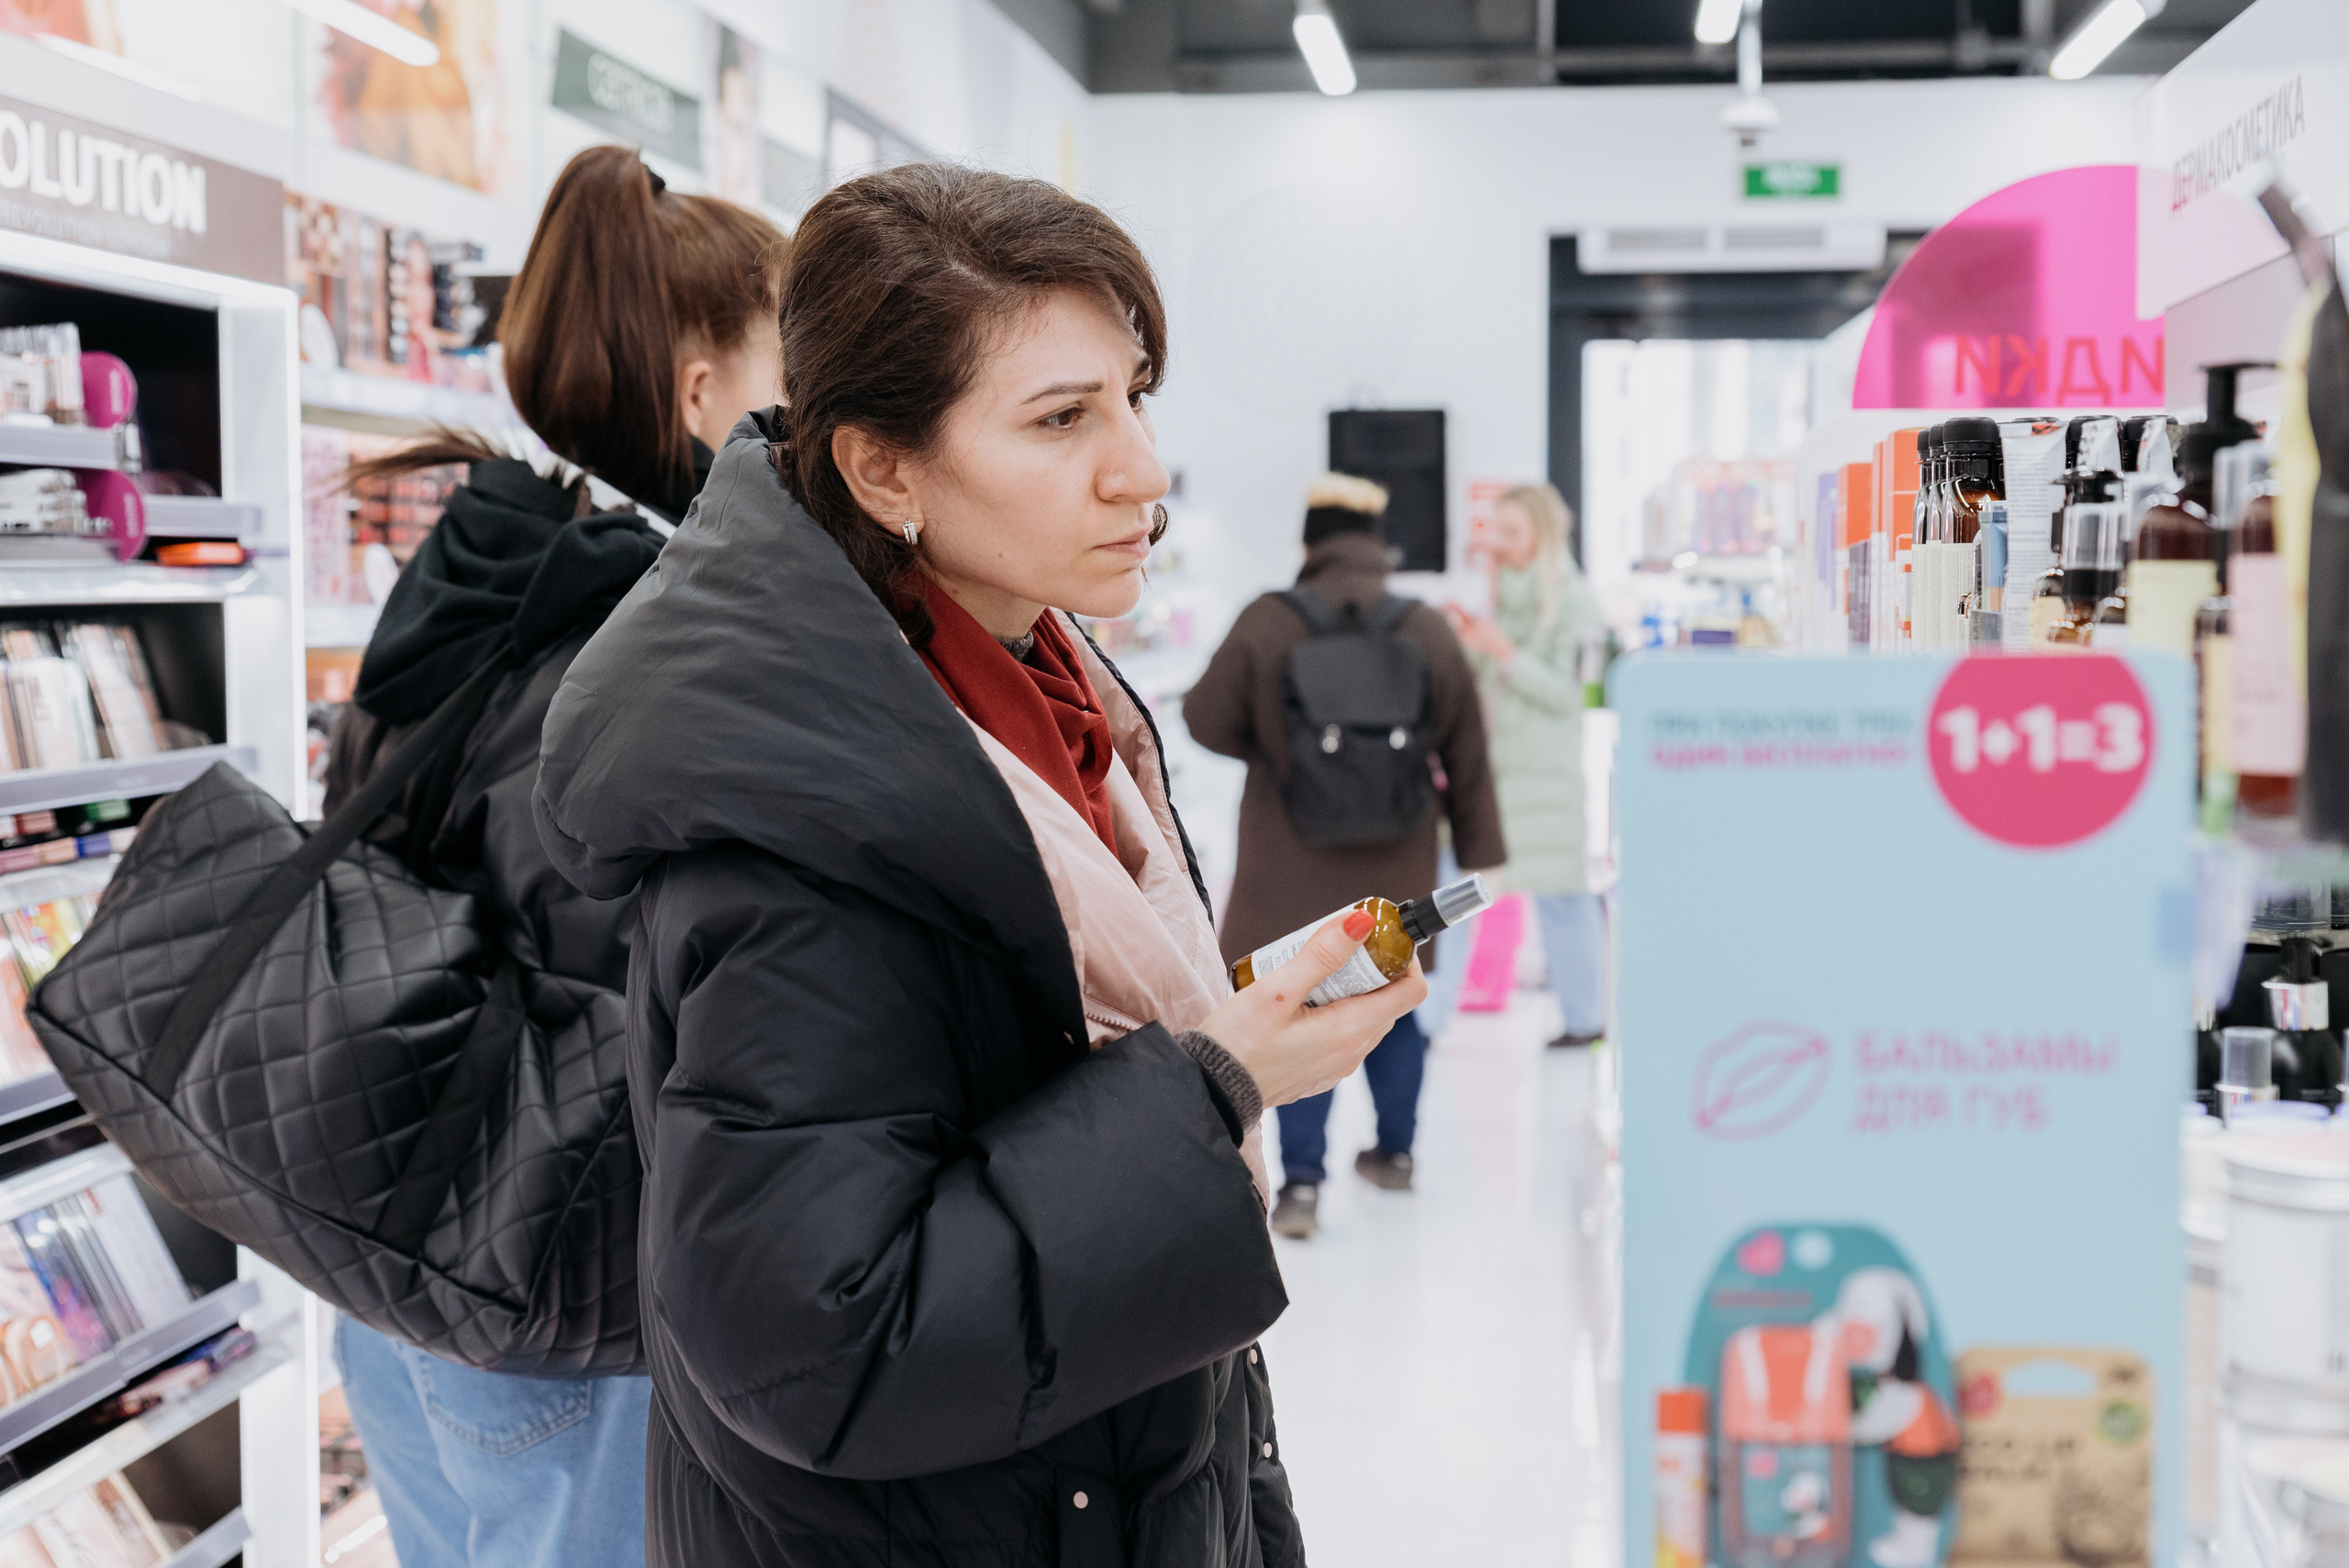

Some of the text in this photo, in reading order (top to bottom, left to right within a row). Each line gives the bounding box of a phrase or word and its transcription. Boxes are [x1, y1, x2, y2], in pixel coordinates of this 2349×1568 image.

[0, 109, 206, 233] OLUTION
[2172, 76, 2305, 217] ДЕРМАКОСМЕТИКА
[1941, 705, 2145, 772] 1+1=3
